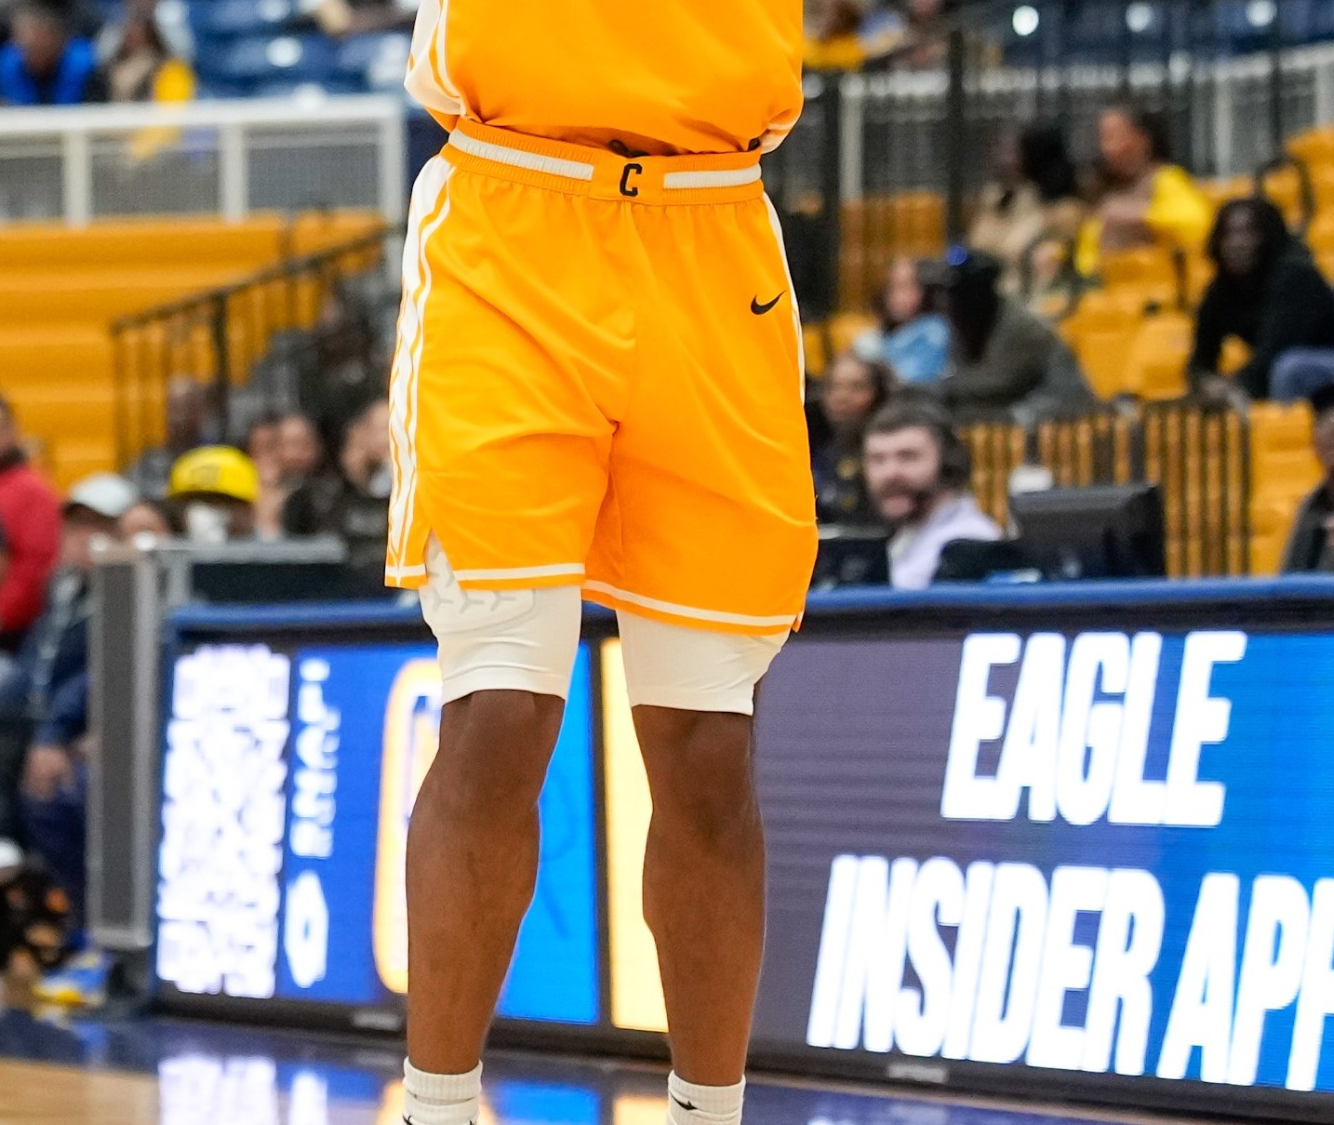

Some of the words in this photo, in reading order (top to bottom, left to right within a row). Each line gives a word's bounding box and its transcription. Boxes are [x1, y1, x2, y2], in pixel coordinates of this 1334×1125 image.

[619, 162, 643, 198] C
[940, 630, 1247, 828] EAGLE
[806, 854, 1165, 1076] INSIDER
